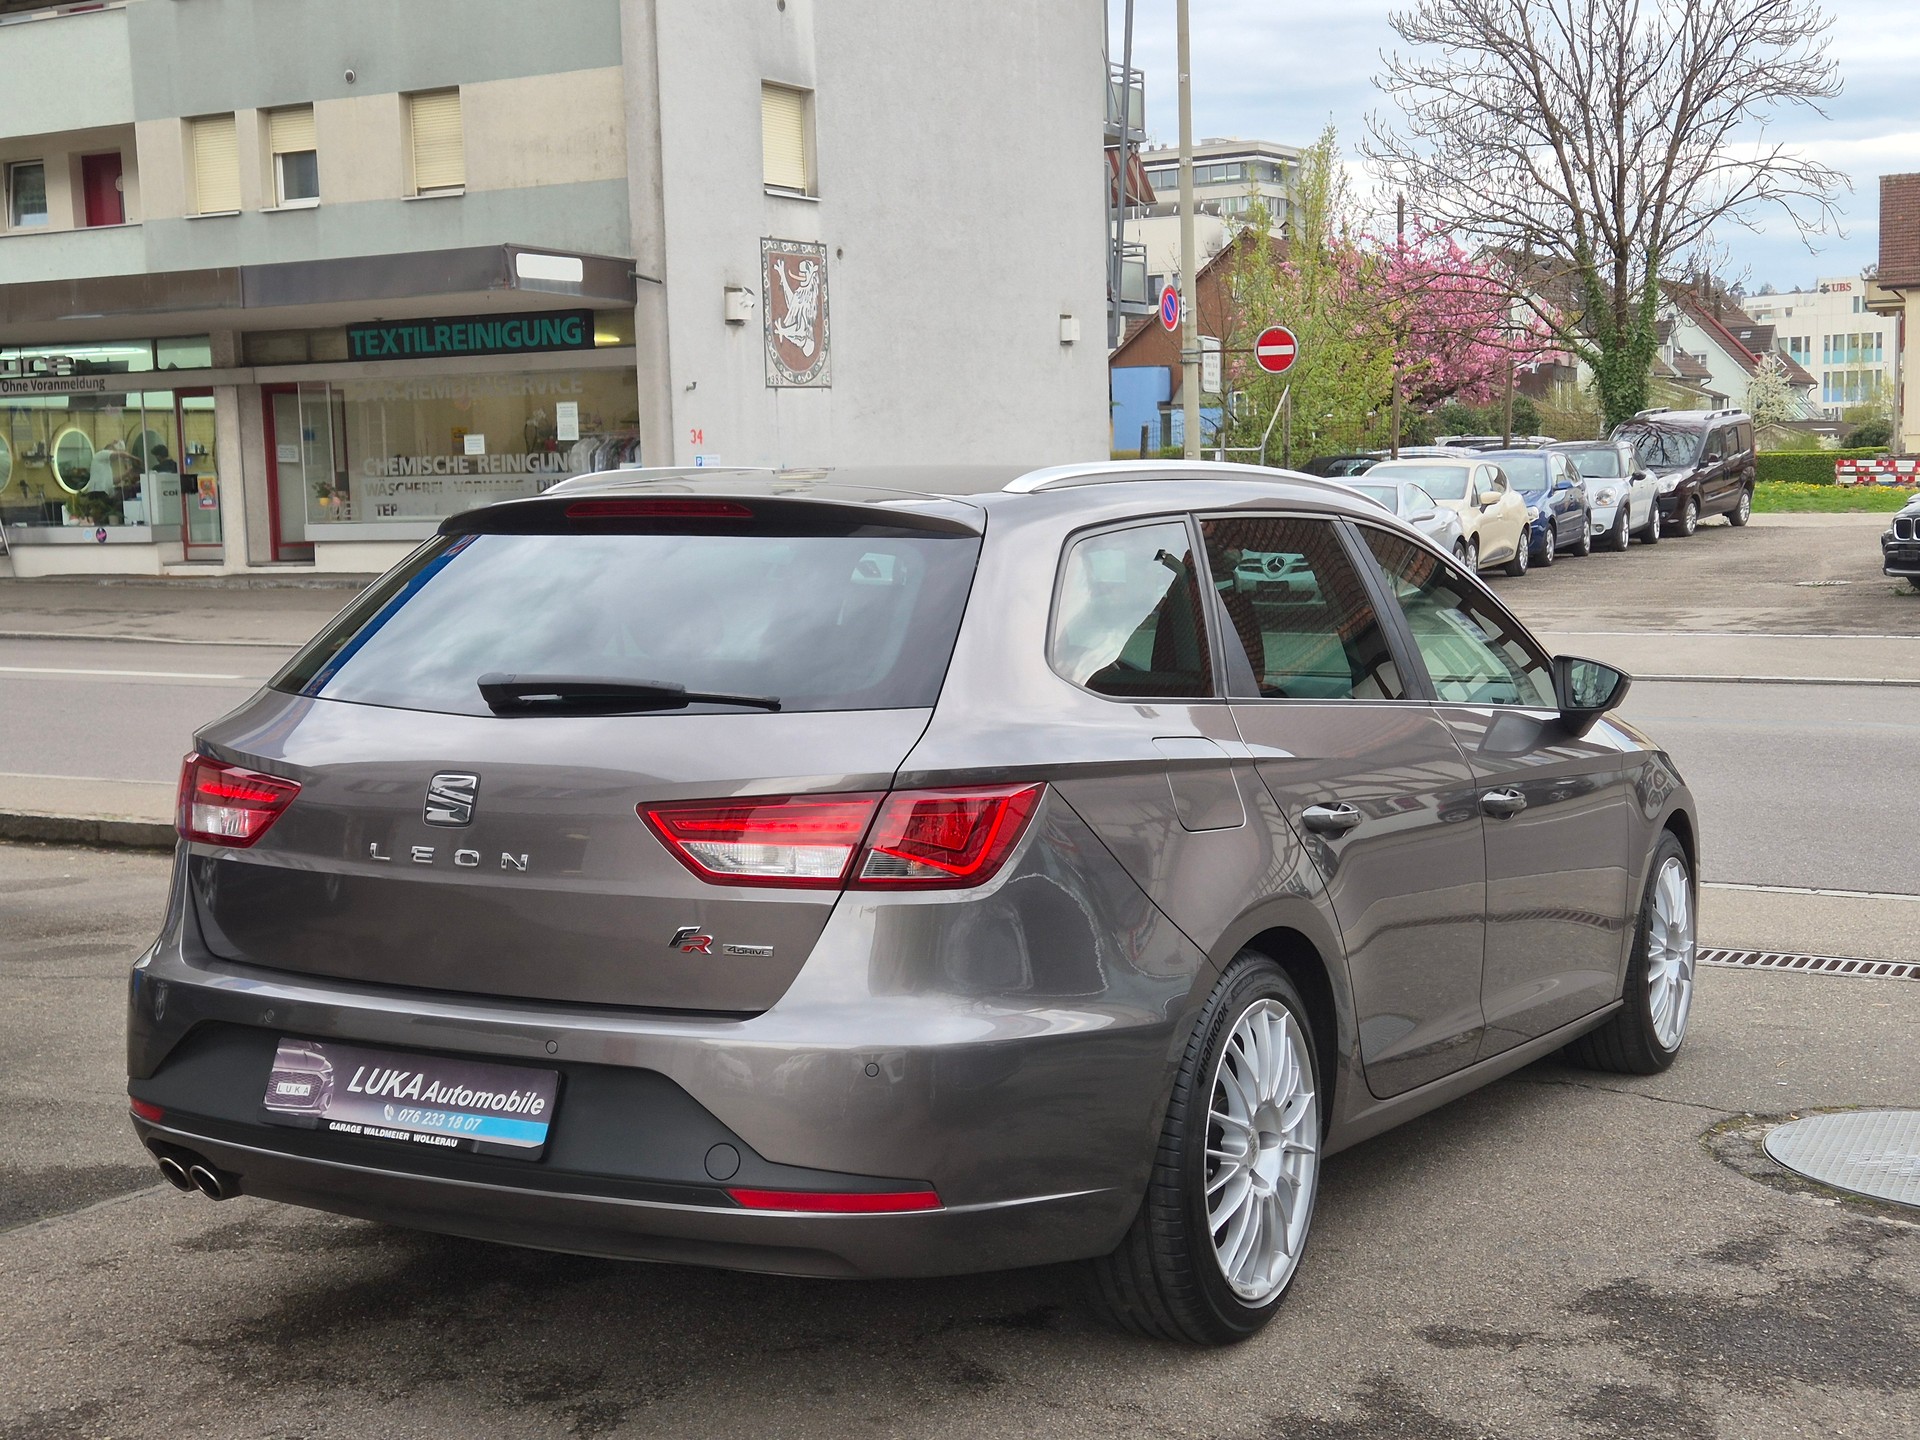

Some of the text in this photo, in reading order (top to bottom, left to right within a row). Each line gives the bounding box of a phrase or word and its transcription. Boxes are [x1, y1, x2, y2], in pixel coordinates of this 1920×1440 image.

[1831, 282, 1852, 292] UBS
[350, 316, 582, 356] TEXTILREINIGUNG
[2, 377, 106, 392] Ohne Voranmeldung
[690, 428, 703, 444] 34
[363, 452, 584, 476] CHEMISCHE REINIGUNG
[369, 842, 529, 872] LEON
[668, 926, 713, 955] FR
[277, 1083, 311, 1095] LUKA
[346, 1066, 545, 1115] LUKA Automobile
[397, 1108, 482, 1132] 076 233 18 07
[329, 1122, 458, 1148] GARAGE WALDMEIER WOLLERAU
